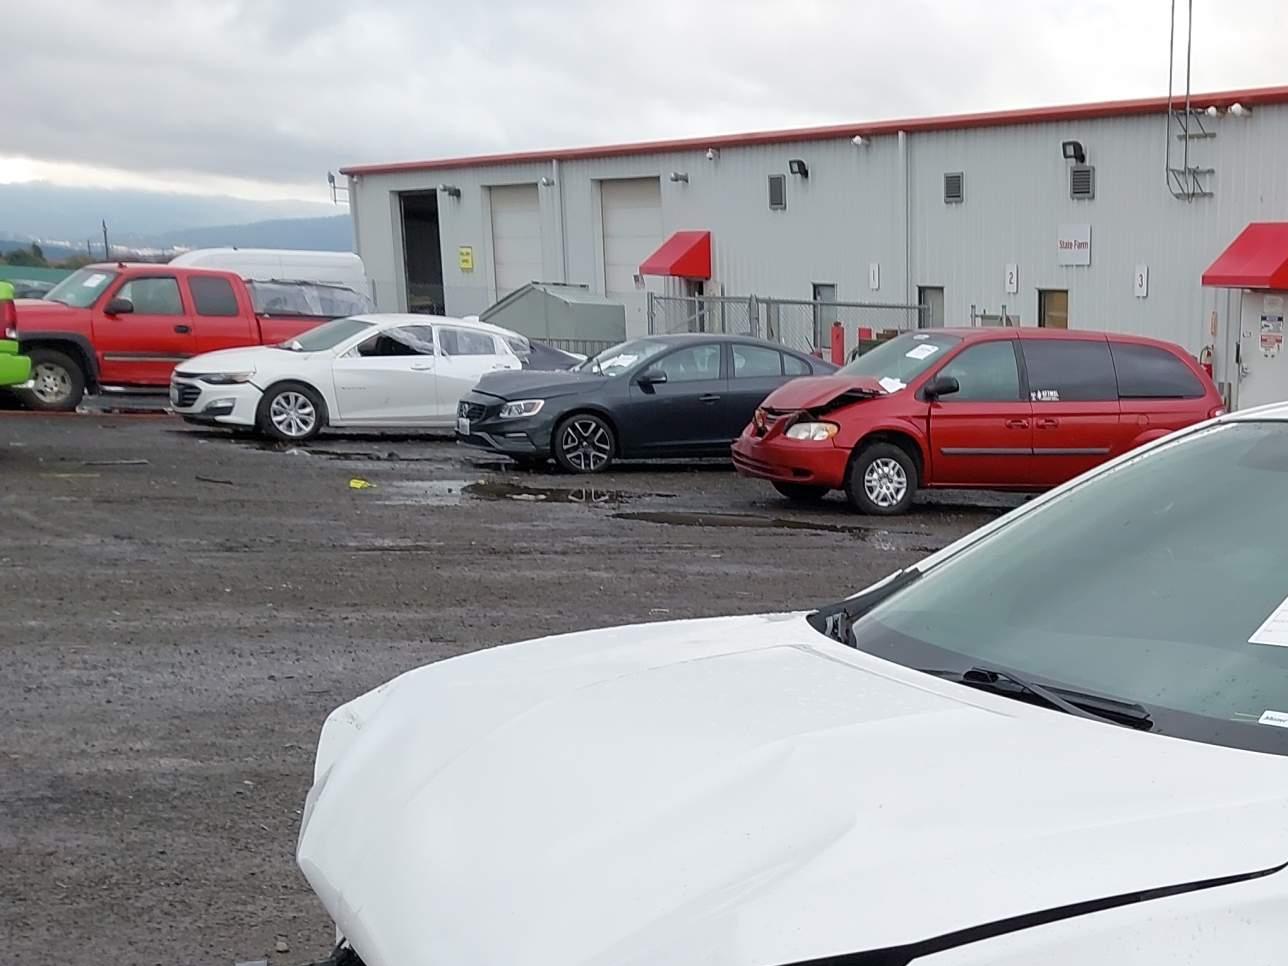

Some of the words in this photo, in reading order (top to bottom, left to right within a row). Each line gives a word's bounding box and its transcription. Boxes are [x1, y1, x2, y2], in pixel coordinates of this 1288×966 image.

[1059, 239, 1073, 250] State
[1073, 239, 1089, 250] Farm
[1008, 271, 1014, 285] 2
[1138, 273, 1144, 289] 3
